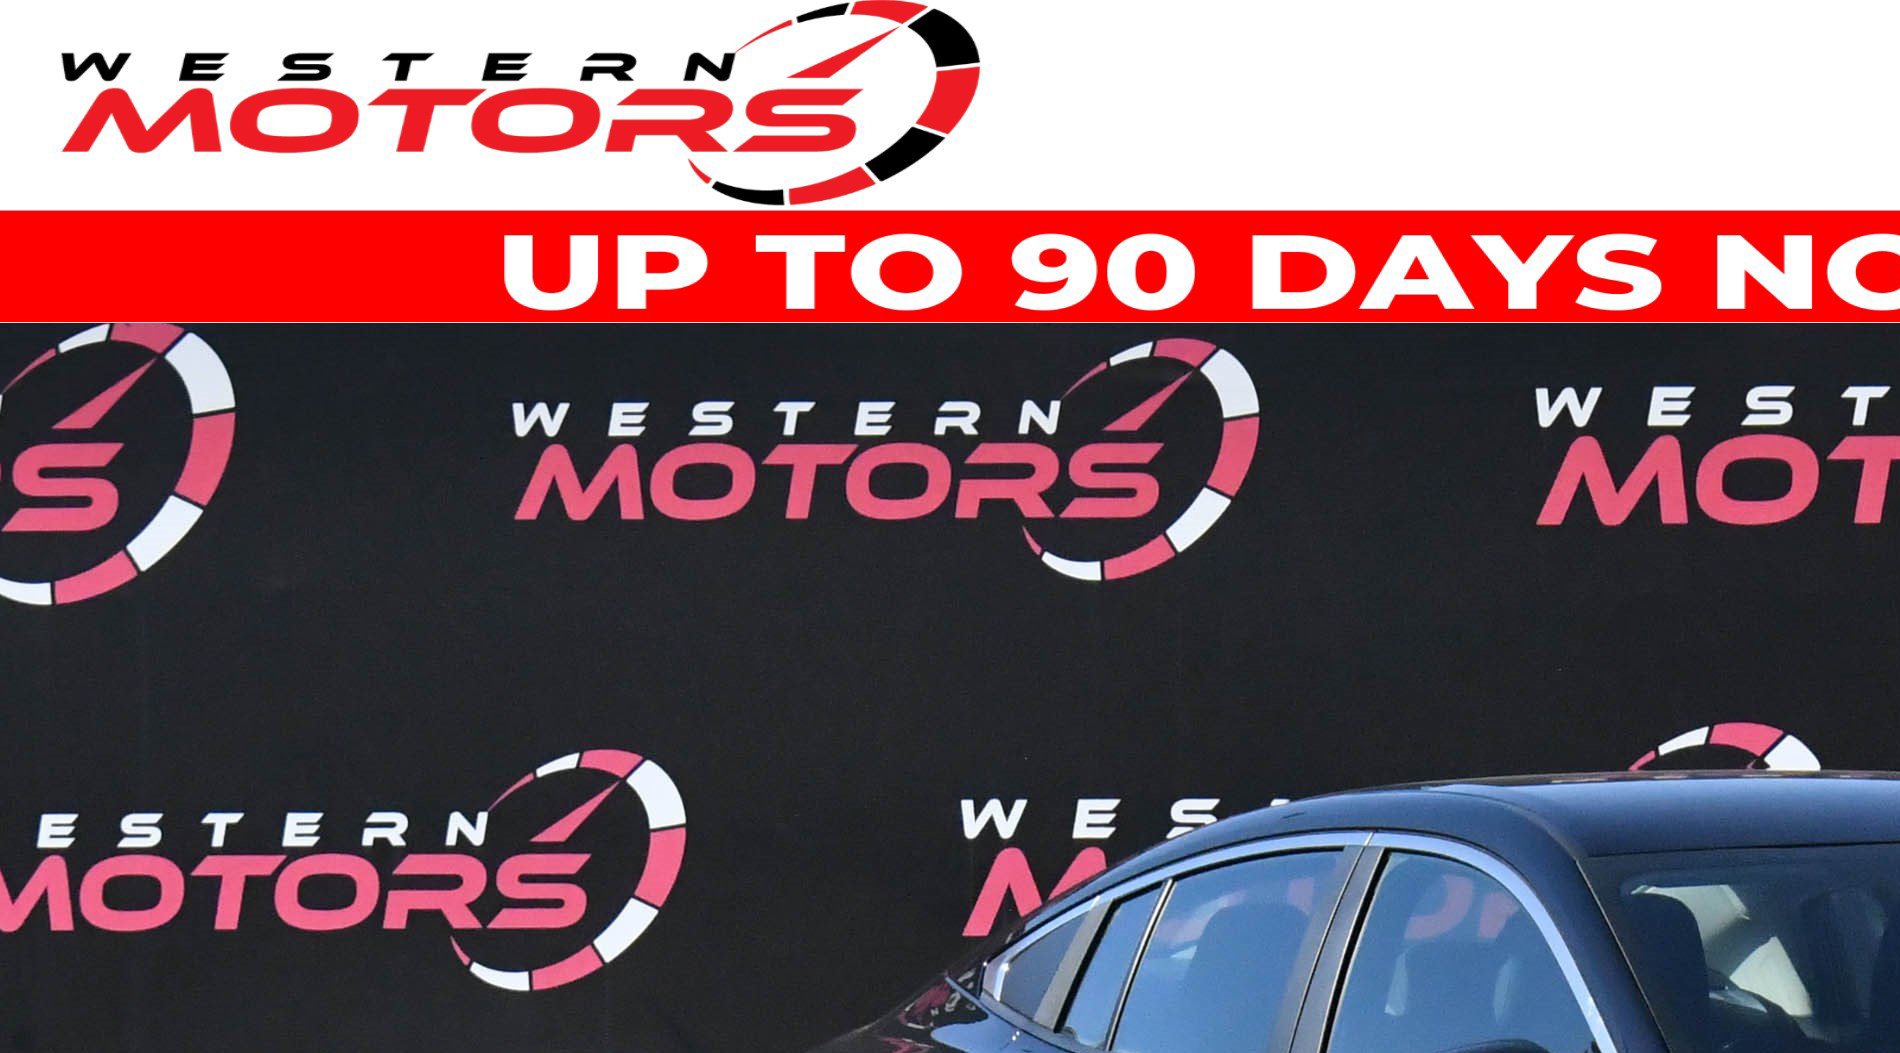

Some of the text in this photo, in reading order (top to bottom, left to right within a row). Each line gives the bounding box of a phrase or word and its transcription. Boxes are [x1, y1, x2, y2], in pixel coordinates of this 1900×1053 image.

[513, 399, 1060, 437] WESTERN
[515, 442, 1164, 521] MOTORS
[36, 812, 489, 849] ESTERN
